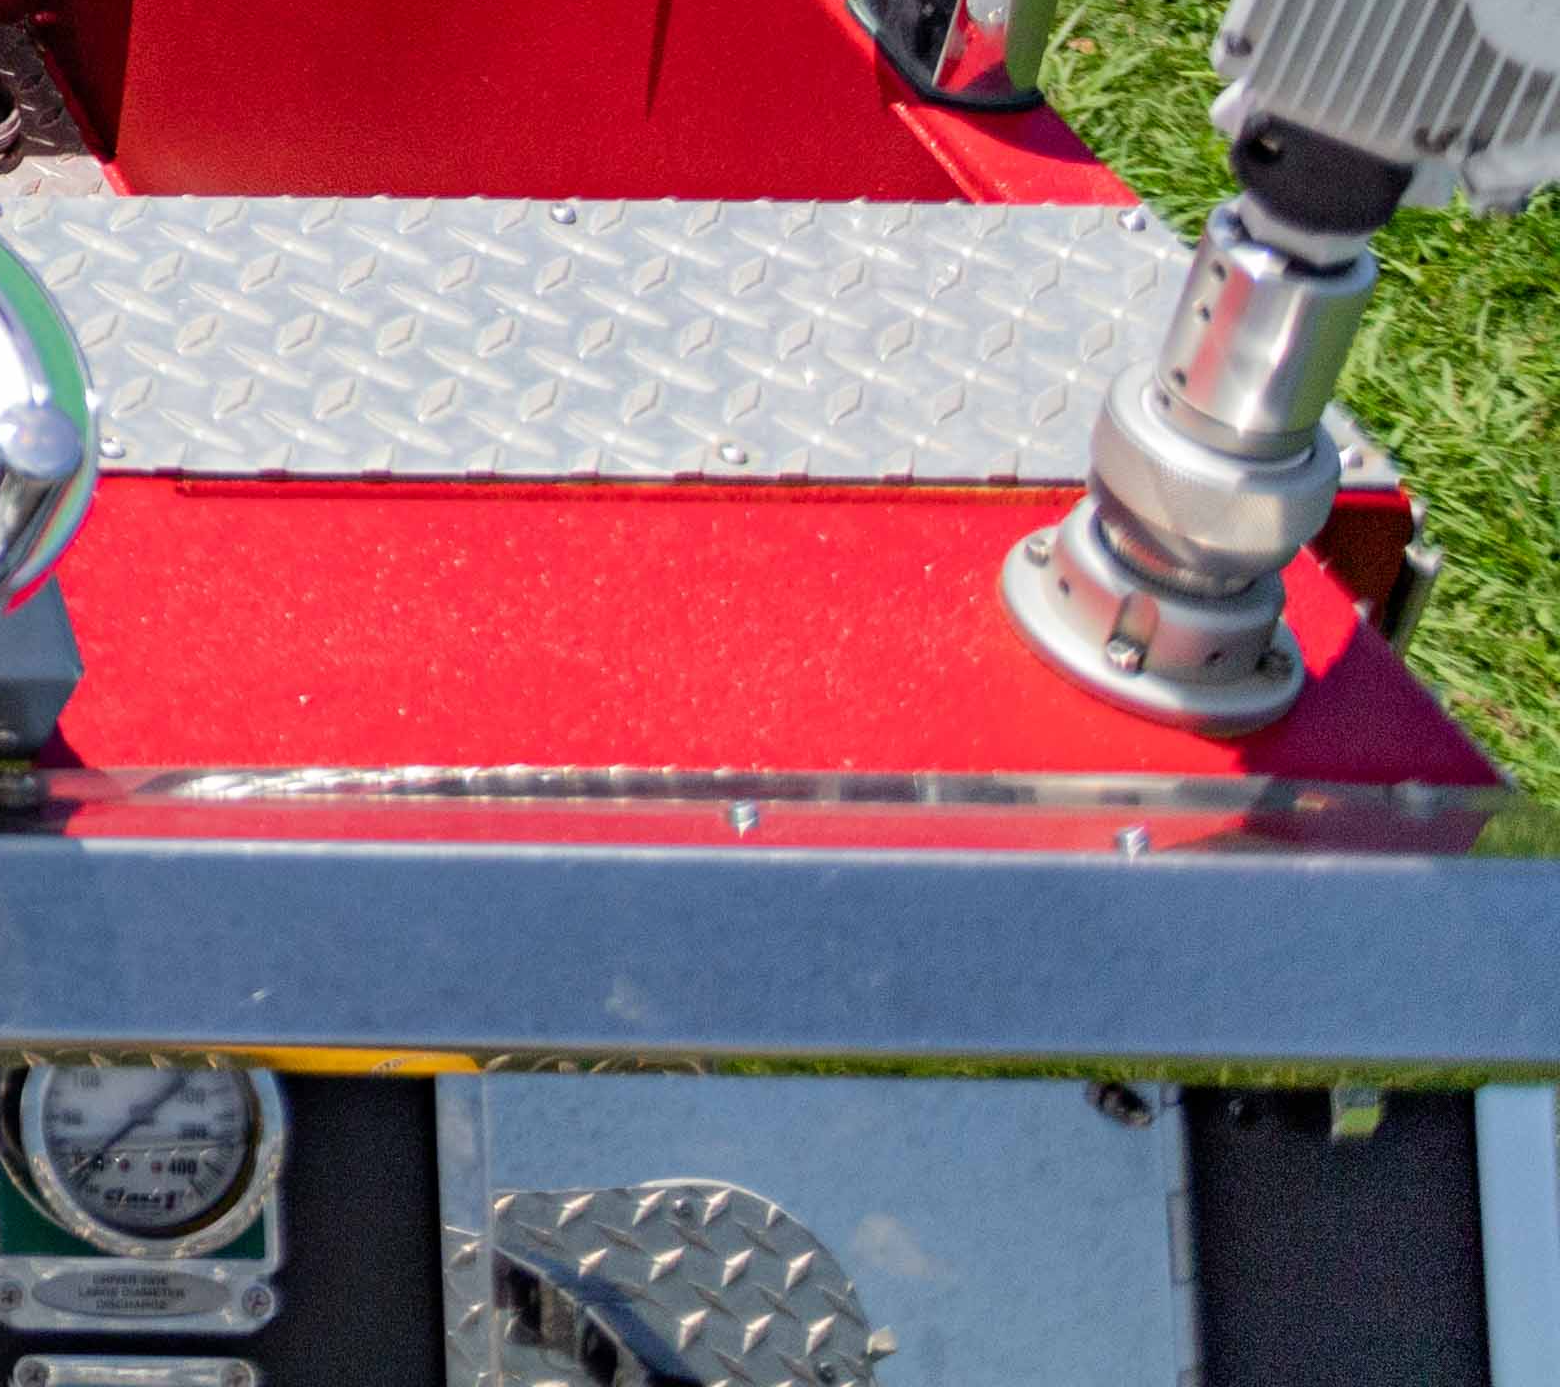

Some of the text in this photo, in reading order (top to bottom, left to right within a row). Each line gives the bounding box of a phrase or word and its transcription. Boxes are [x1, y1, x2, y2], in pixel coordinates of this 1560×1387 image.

[168, 1159, 197, 1175] 400
[77, 1288, 187, 1300] LARGE DIAMETER
[95, 1299, 168, 1311] DISCHARGE
